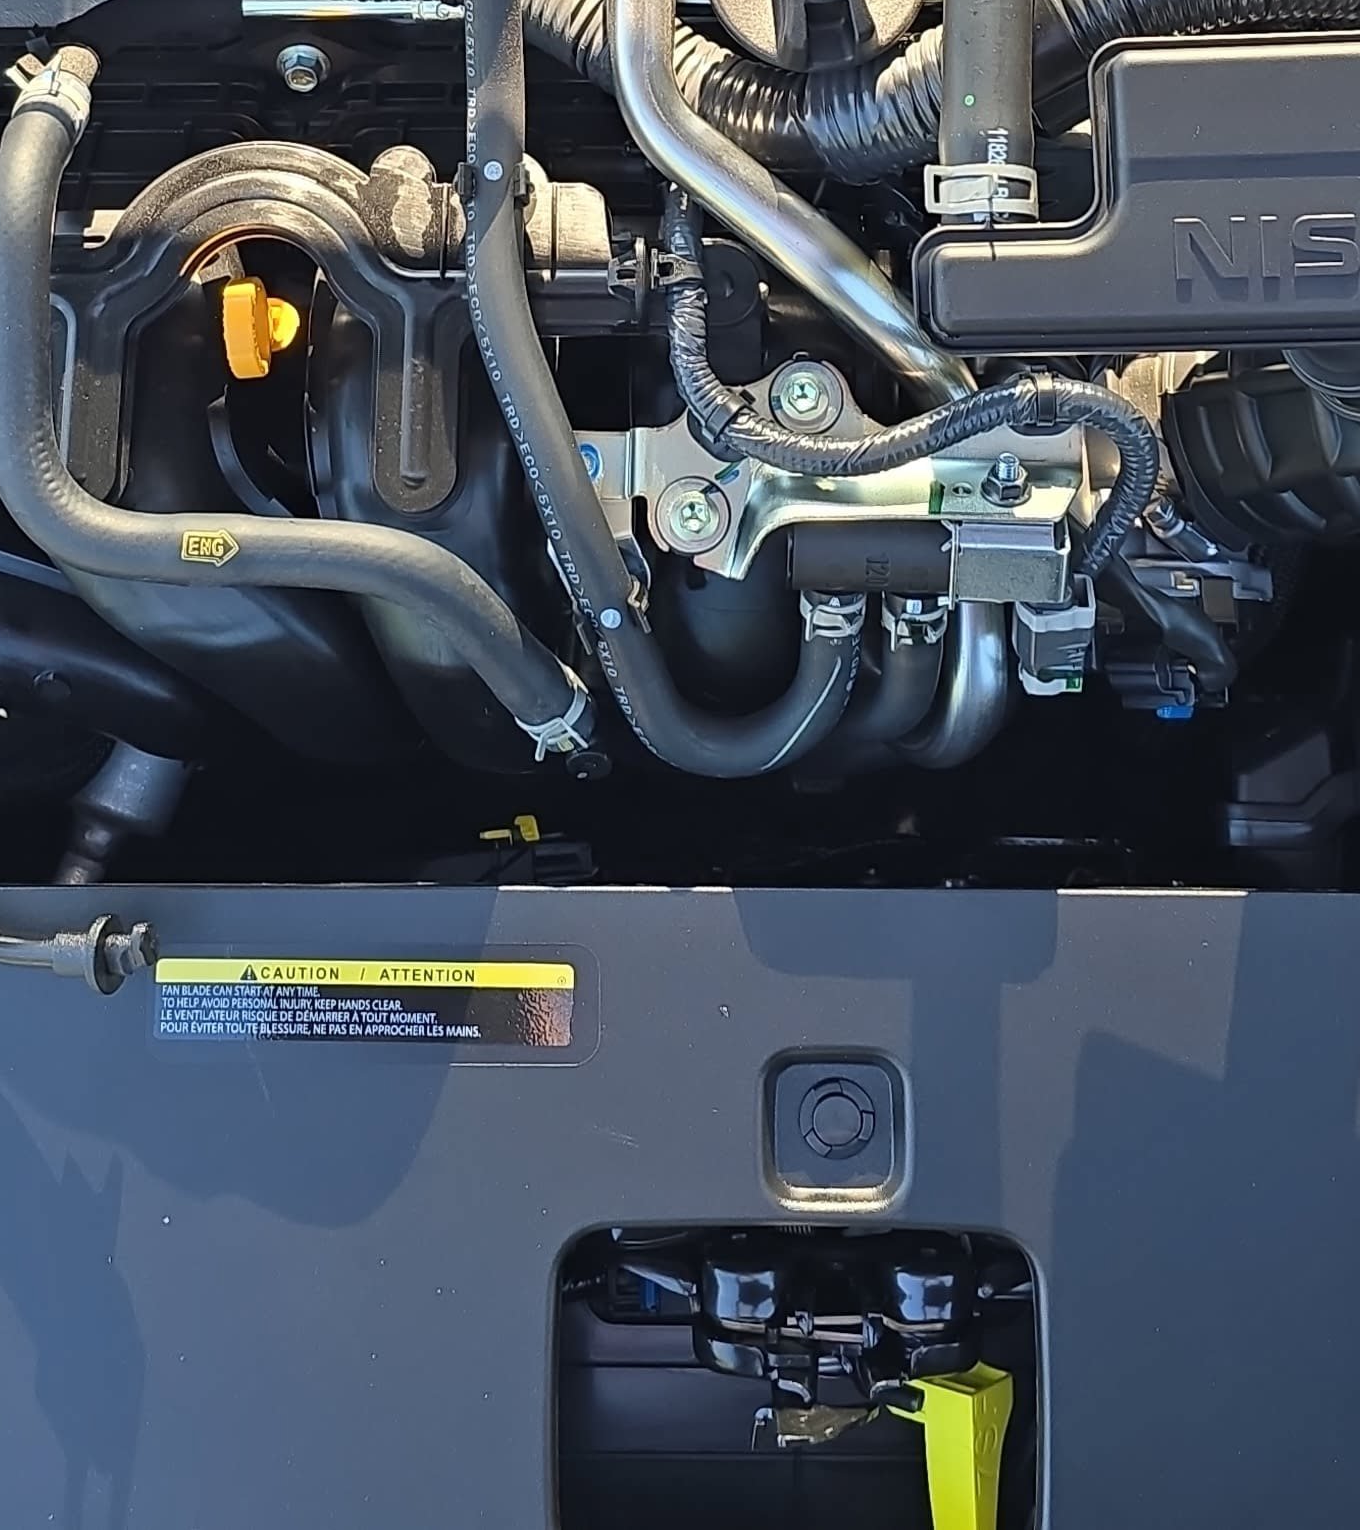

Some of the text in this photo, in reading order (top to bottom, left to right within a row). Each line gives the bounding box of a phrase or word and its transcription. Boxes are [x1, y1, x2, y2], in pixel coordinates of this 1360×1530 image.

[188, 537, 224, 557] ENG
[260, 966, 476, 983] CAUTION / ATTENTION
[162, 985, 320, 997] FAN BLADE CAN START AT ANY TIME.
[162, 998, 403, 1011] TO HELP AVOID PERSONAL INJURY, KEEP HANDS CLEAR.
[161, 1009, 437, 1024] LE VENTILATEUR RISQUE DE DÉMARRER À TOUT MOMENT.
[160, 1020, 481, 1038] POUR ÉVITER TOUTE BLESSURE, NE PAS EN APPROCHER LES MAINS.
